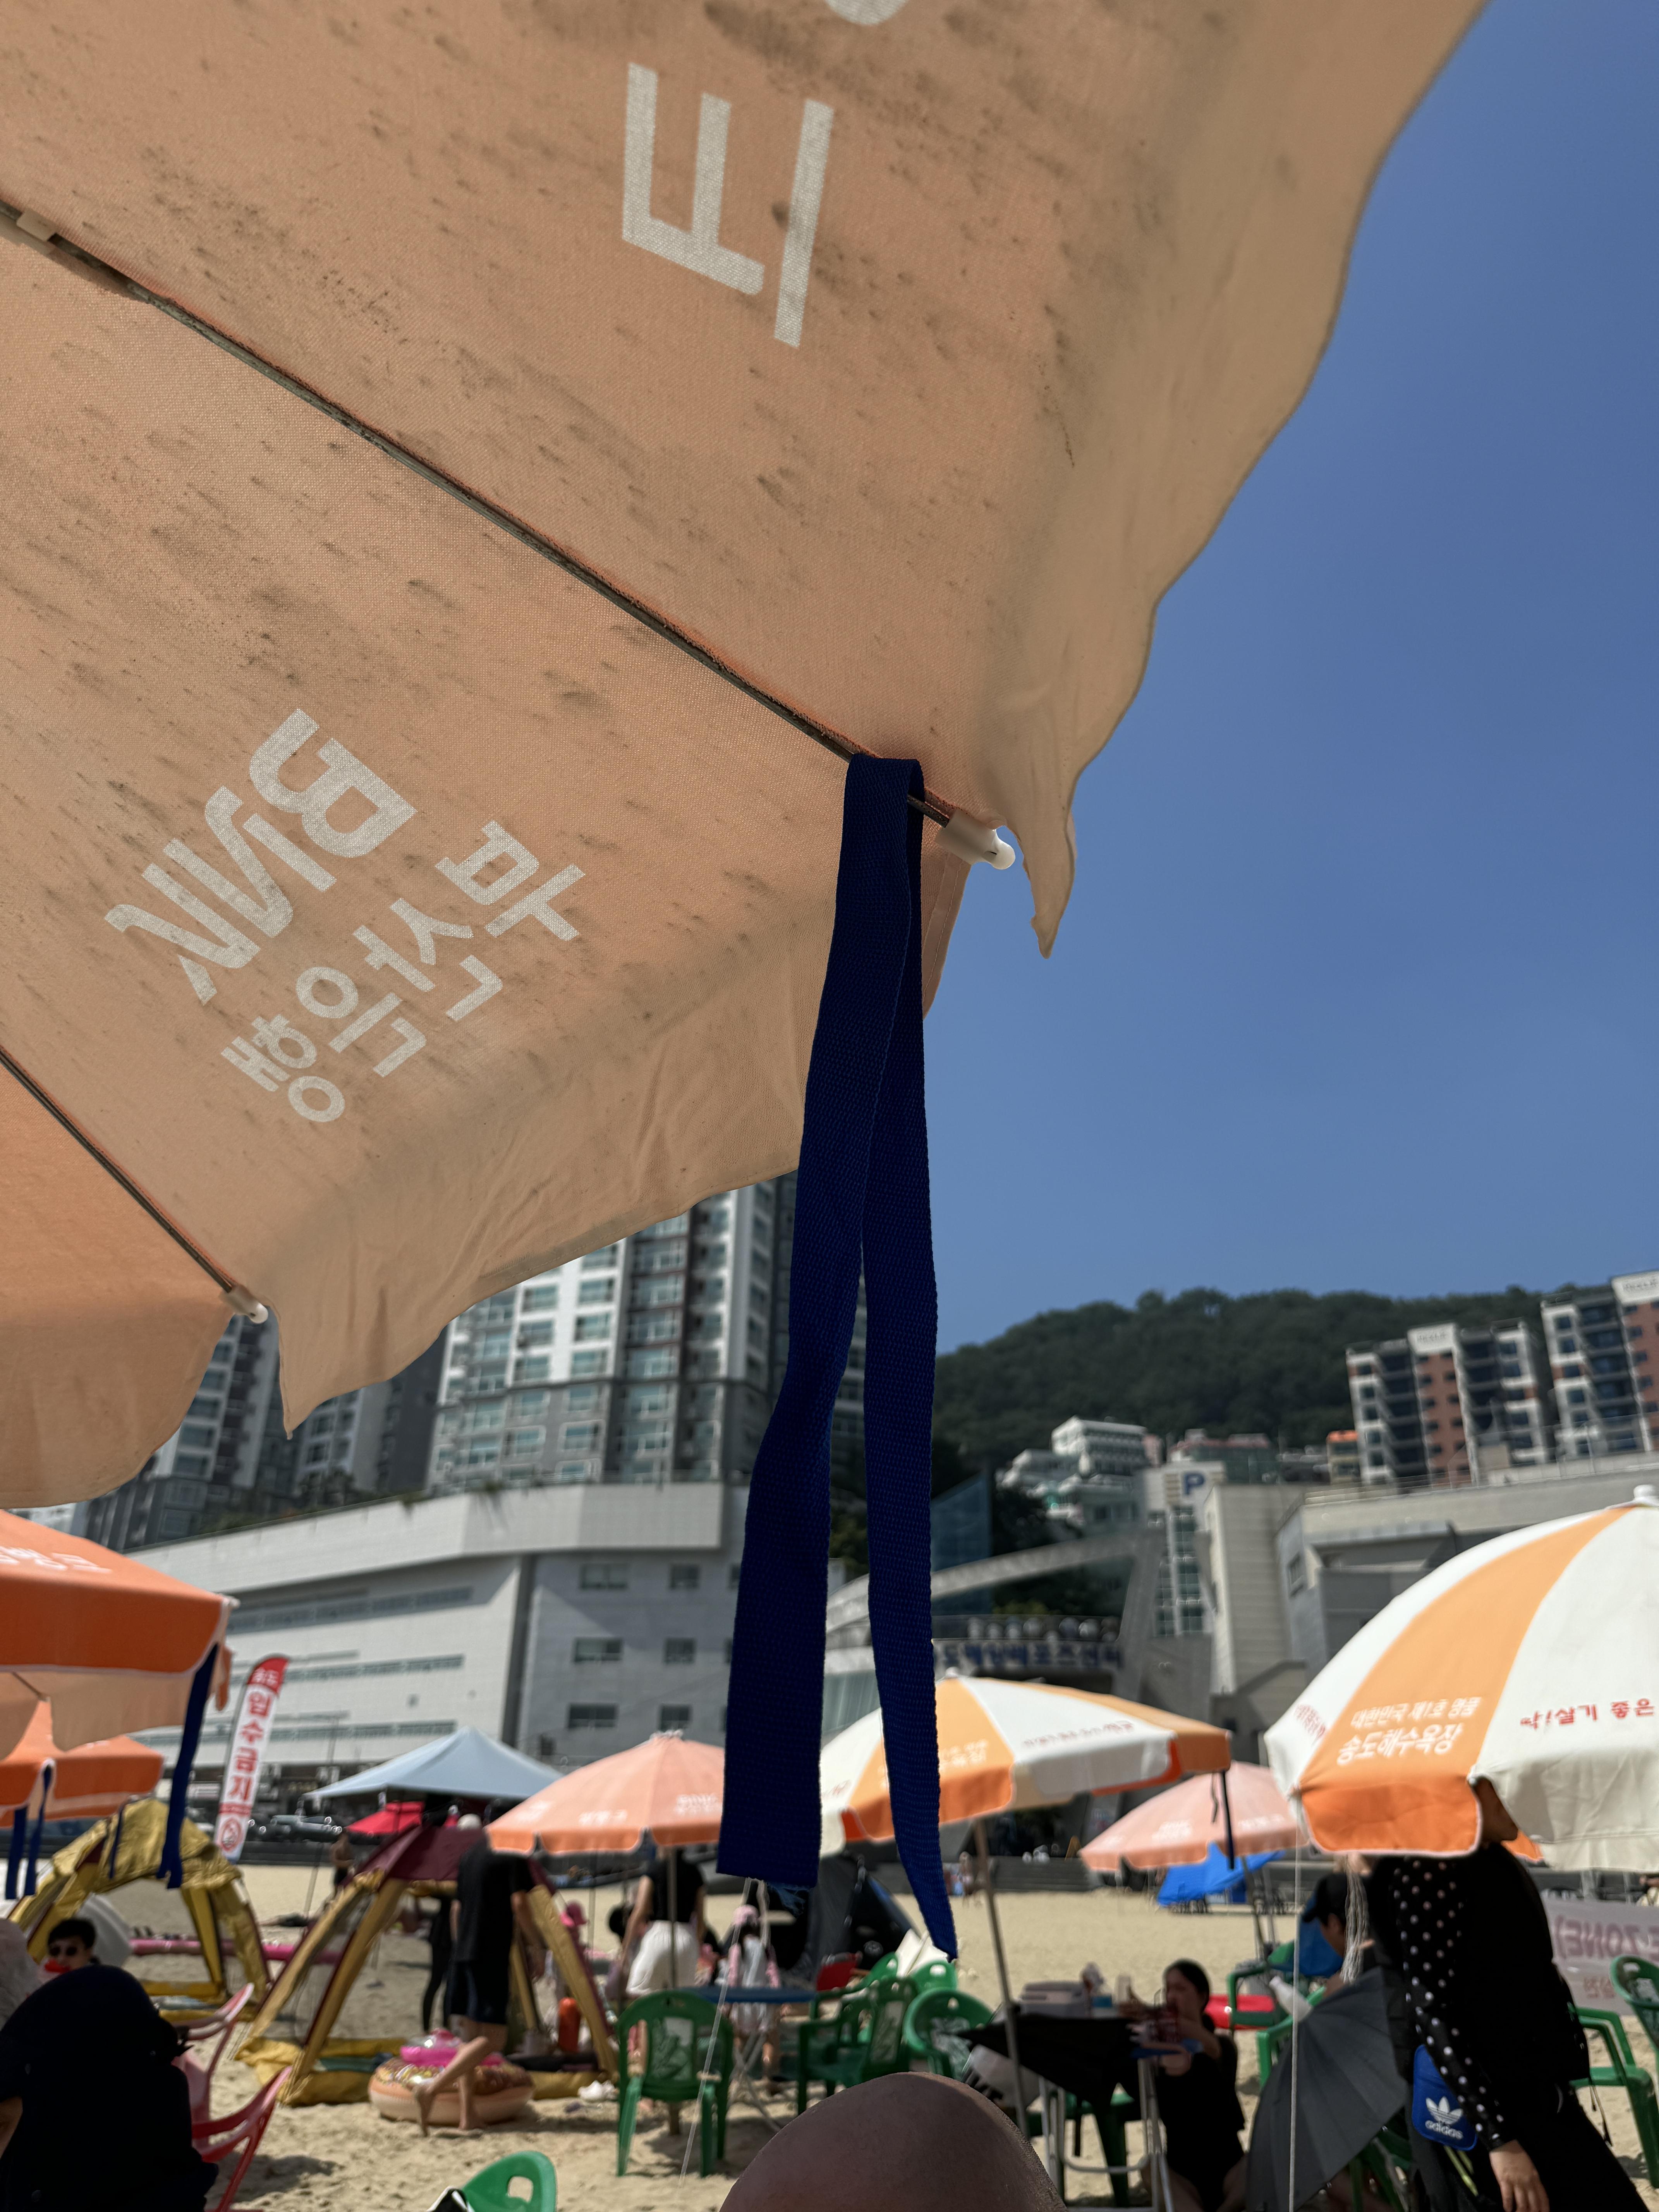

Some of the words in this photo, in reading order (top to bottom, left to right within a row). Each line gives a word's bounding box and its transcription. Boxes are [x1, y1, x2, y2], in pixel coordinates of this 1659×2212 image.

[1184, 1472, 1205, 1496] P
[1350, 1702, 1410, 1729] 대한민국
[1448, 1696, 1482, 1719] 명품
[1610, 1698, 1654, 1719] 좋은
[230, 1691, 273, 1802] 입수금지
[1336, 1722, 1465, 1766] 송도해수욕장
[1425, 2120, 1463, 2140] adidas
